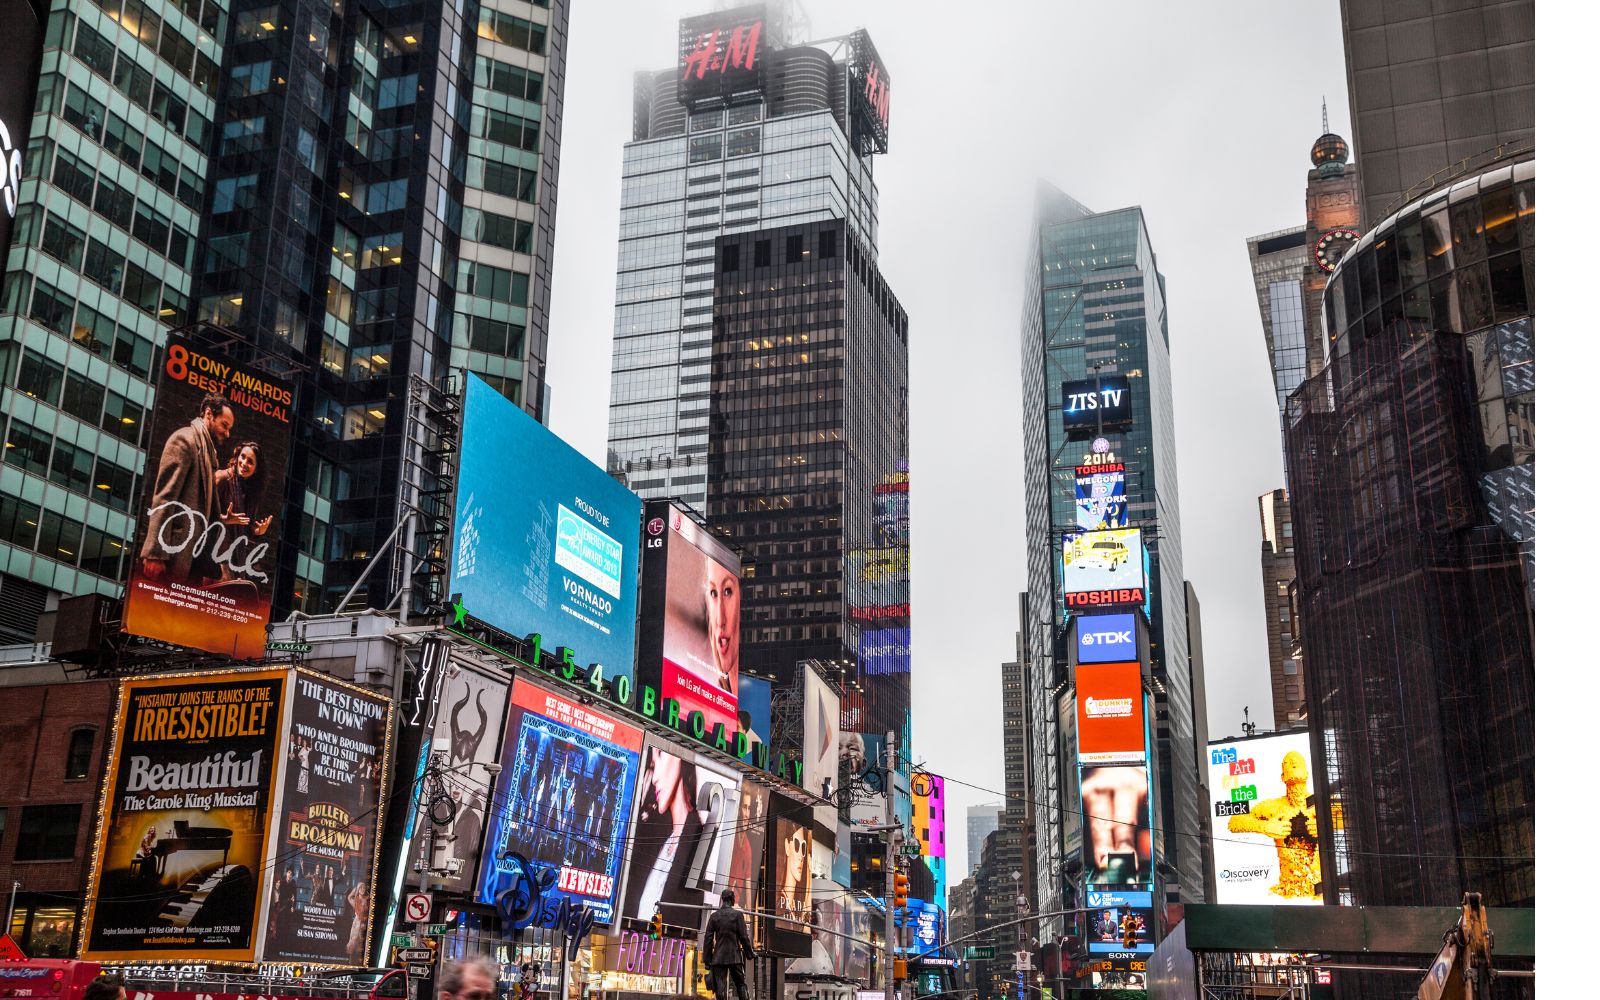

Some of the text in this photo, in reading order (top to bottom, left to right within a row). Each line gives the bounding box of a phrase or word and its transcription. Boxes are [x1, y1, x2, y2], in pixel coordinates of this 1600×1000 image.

[682, 20, 763, 80] H&M
[865, 60, 890, 130] H&M
[166, 344, 189, 380] 8
[190, 351, 292, 405] TONY AWARDS
[188, 371, 289, 423] BEST MUSICAL
[1076, 463, 1125, 475] TOSHIBA
[1083, 452, 1116, 466] 2014
[1076, 474, 1125, 486] WELCOME
[1095, 486, 1108, 494] TO
[1076, 494, 1128, 506] NEW YORK
[575, 496, 610, 528] PROUD TO BE
[583, 527, 606, 551] ENERGY
[605, 542, 620, 560] STAR
[647, 538, 663, 548] LG
[583, 544, 603, 567] AWARD
[153, 593, 199, 611] telecharge.com
[171, 581, 236, 606] oncemusical.com
[562, 576, 612, 614] VORNADO
[1065, 589, 1143, 606] TOSHIBA
[589, 606, 604, 618] TRUST
[270, 643, 309, 651] LAMAR
[1093, 631, 1132, 644] TDK
[532, 633, 630, 704] 1540
[178, 690, 200, 706] JOINS
[201, 689, 215, 704] THE
[217, 687, 243, 703] RANKS
[244, 687, 255, 702] OF
[255, 686, 271, 702] THE
[677, 673, 686, 687] Join
[686, 678, 693, 690] LG
[692, 683, 702, 696] and
[701, 688, 713, 701] make
[318, 703, 331, 720] IN
[325, 687, 352, 708] BEST
[352, 698, 384, 720] SHOW
[545, 695, 556, 709] BEST
[573, 705, 585, 718] BEST
[545, 709, 559, 719] 2012
[559, 713, 573, 725] TONY
[574, 718, 591, 731] AWARD
[317, 730, 338, 745] KNEW
[339, 737, 377, 756] BROADWAY
[643, 685, 803, 785] BROADWAY
[314, 741, 359, 763] COULD STILL
[1213, 751, 1235, 763] The
[126, 749, 264, 792] Beautiful
[313, 764, 336, 781] MUCH
[321, 754, 350, 772] BE THIS
[1233, 762, 1251, 775] Art
[124, 790, 258, 812] The Carole King Musical
[1234, 789, 1254, 801] the
[308, 804, 350, 826] BULLETS
[1218, 802, 1247, 816] Brick
[320, 818, 337, 828] OVER
[290, 821, 363, 851] BROADWAY
[685, 782, 741, 896] 21
[317, 847, 344, 858] MUSICAL
[558, 867, 614, 898] NEWSIES
[1223, 869, 1269, 879] Discovery
[321, 908, 337, 916] ALLEN
[496, 851, 594, 961] Disney
[780, 896, 807, 912] PRADA
[296, 929, 338, 941] SUSAN STROMAN
[435, 925, 441, 934] 46
[616, 930, 687, 977] FOREVER
[258, 964, 294, 981] GIFTS
